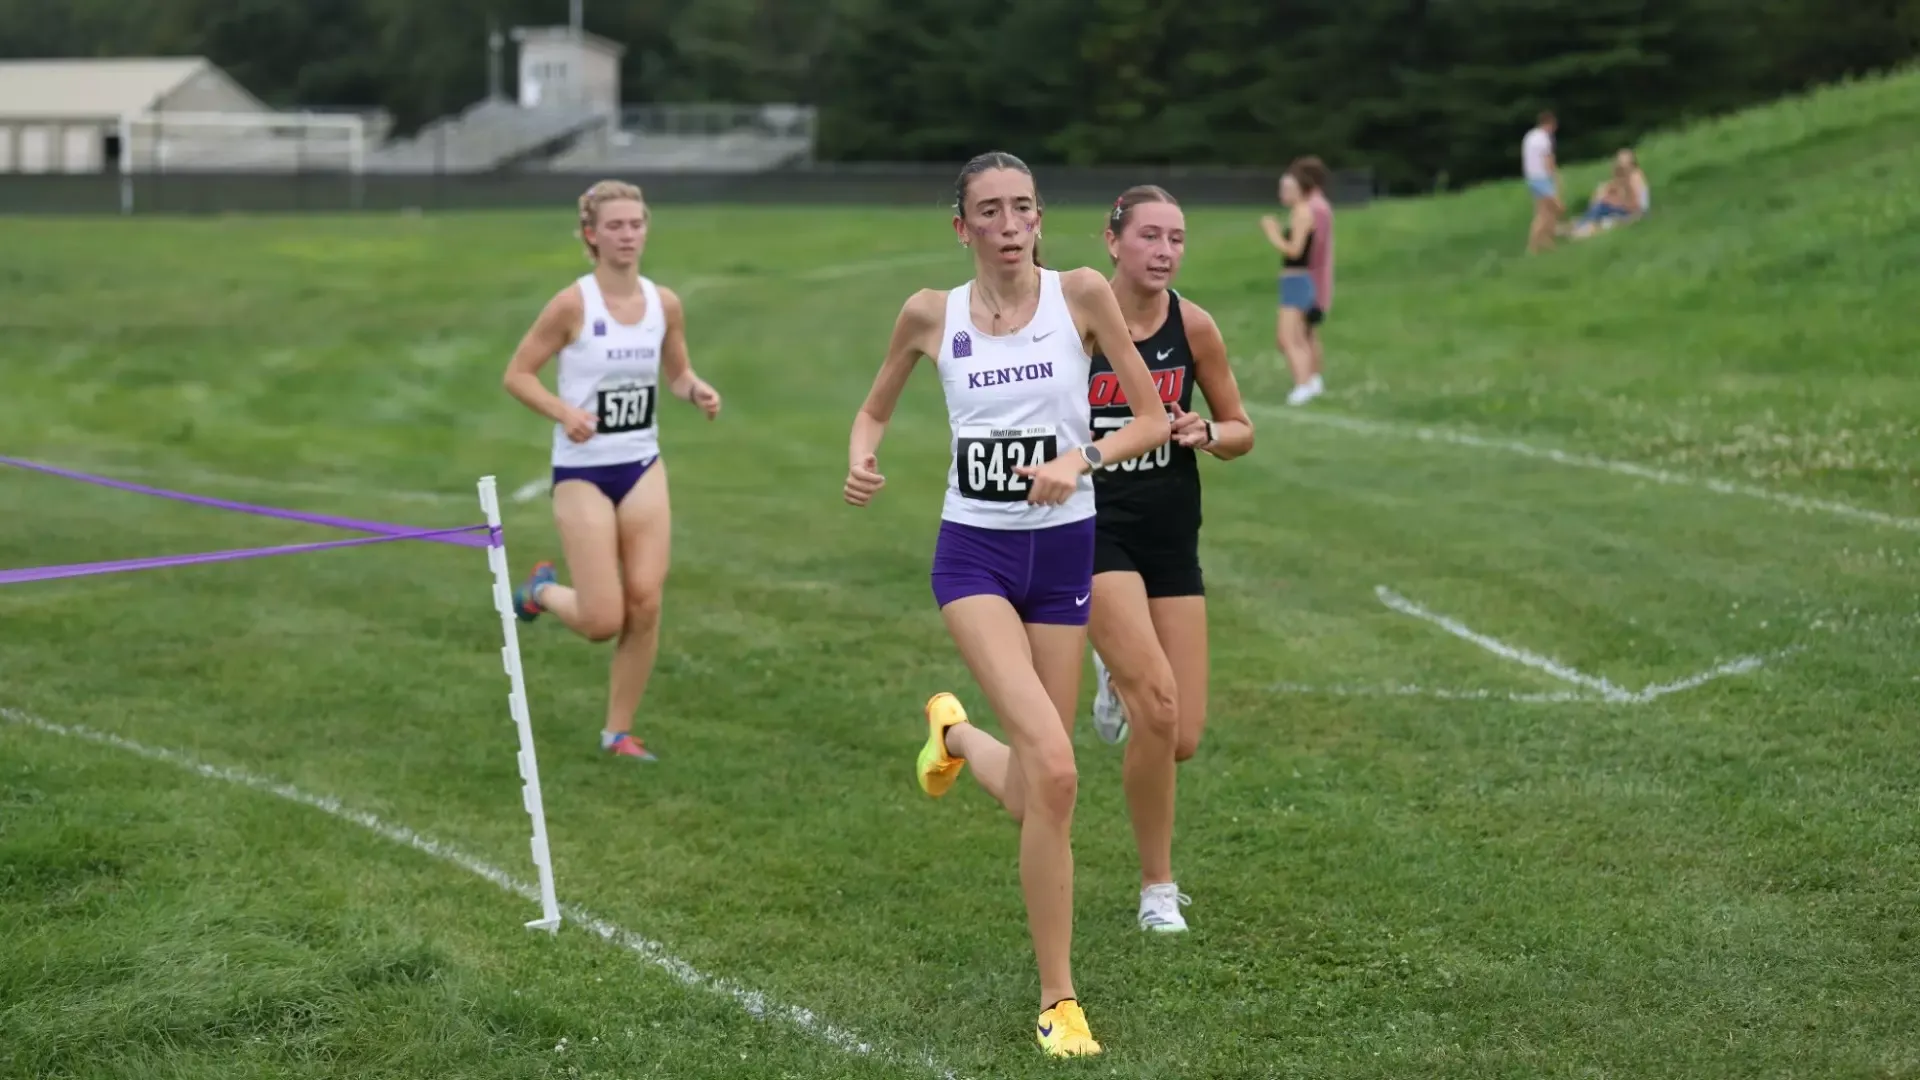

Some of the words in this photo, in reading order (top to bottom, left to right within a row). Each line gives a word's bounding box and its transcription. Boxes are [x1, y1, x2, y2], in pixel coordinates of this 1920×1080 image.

[968, 362, 1053, 388] KENYON
[606, 388, 648, 427] 5737
[968, 441, 1045, 491] 6424
